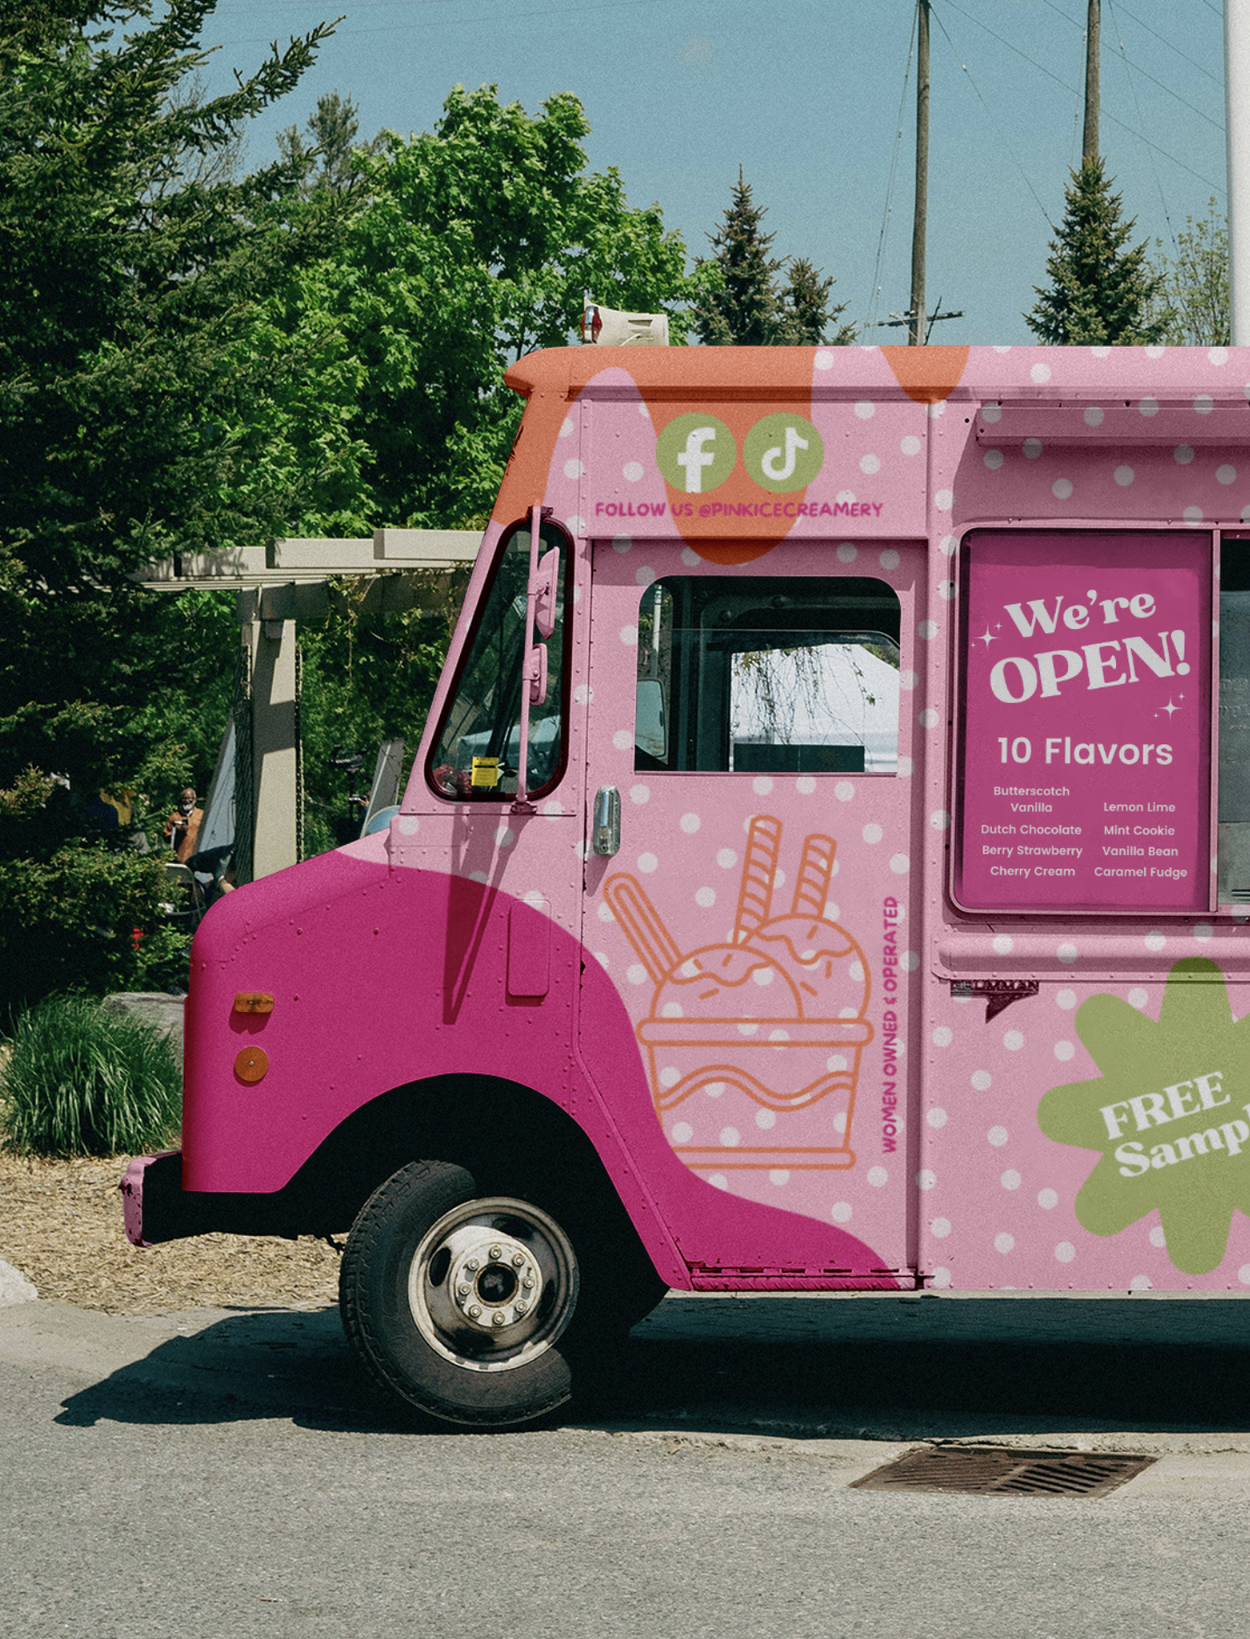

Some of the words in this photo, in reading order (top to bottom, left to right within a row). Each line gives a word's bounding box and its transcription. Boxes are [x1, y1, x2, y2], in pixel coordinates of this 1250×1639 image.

[595, 502, 666, 517] FOLLOW
[671, 502, 694, 517] US
[699, 502, 883, 518] @PINKICECREAMERY
[990, 629, 1191, 704] OPEN!
[997, 737, 1032, 764] 10
[1045, 736, 1173, 765] Flavors
[994, 786, 1070, 796] Butterscotch
[1010, 802, 1053, 812] Vanilla
[1103, 802, 1144, 812] Lemon
[1147, 802, 1176, 812] Lime
[981, 824, 1016, 834] Dutch
[1019, 824, 1082, 835] Chocolate
[1104, 825, 1130, 835] Mint
[1133, 825, 1175, 836] Cookie
[982, 845, 1014, 858] Berry
[1017, 845, 1083, 858] Strawberry
[1102, 846, 1145, 856] Vanilla
[1148, 846, 1179, 856] Bean
[990, 866, 1031, 878] Cherry
[1034, 866, 1076, 876] Cream
[1094, 866, 1147, 877] Caramel
[1150, 867, 1188, 880] Fudge
[882, 896, 898, 992] OPERATED
[882, 1011, 898, 1076] OWNED
[1099, 1071, 1231, 1140] FREE
[882, 1081, 898, 1153] WOMEN
